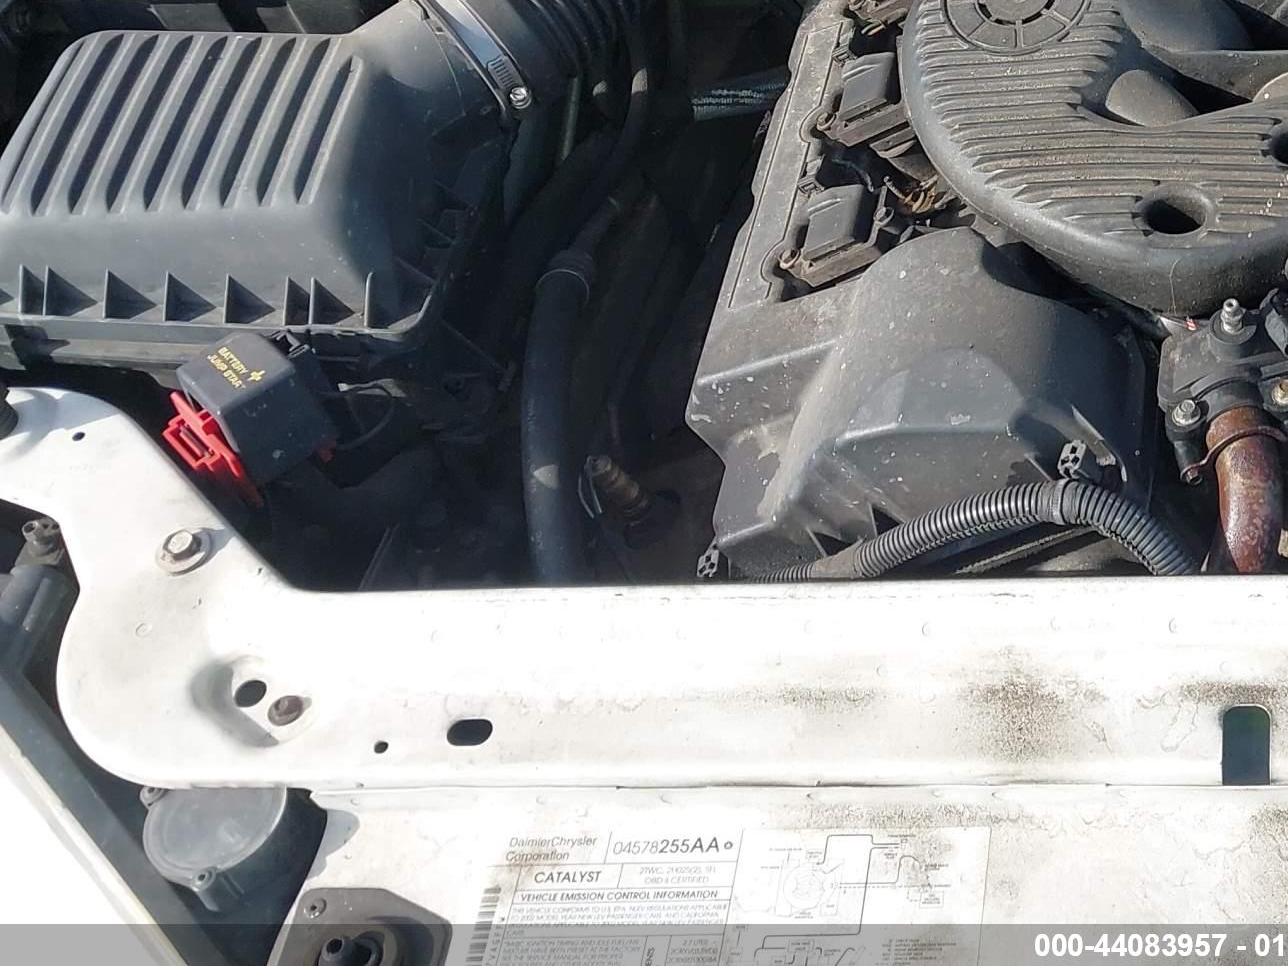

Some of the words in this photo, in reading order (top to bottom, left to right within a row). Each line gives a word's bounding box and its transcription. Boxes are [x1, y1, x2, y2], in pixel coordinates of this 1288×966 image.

[218, 346, 249, 375] BATTERY
[207, 354, 227, 372] JUMP
[223, 369, 247, 389] START
[509, 835, 598, 848] DaimlerChrysler
[612, 837, 720, 855] 04578255AA
[505, 850, 570, 863] Corporation
[533, 870, 602, 884] CATALYST
[520, 893, 558, 902] VEHICLE
[560, 892, 604, 902] EMISSION
[609, 891, 651, 901] CONTROL
[653, 890, 718, 900] INFORMATION
